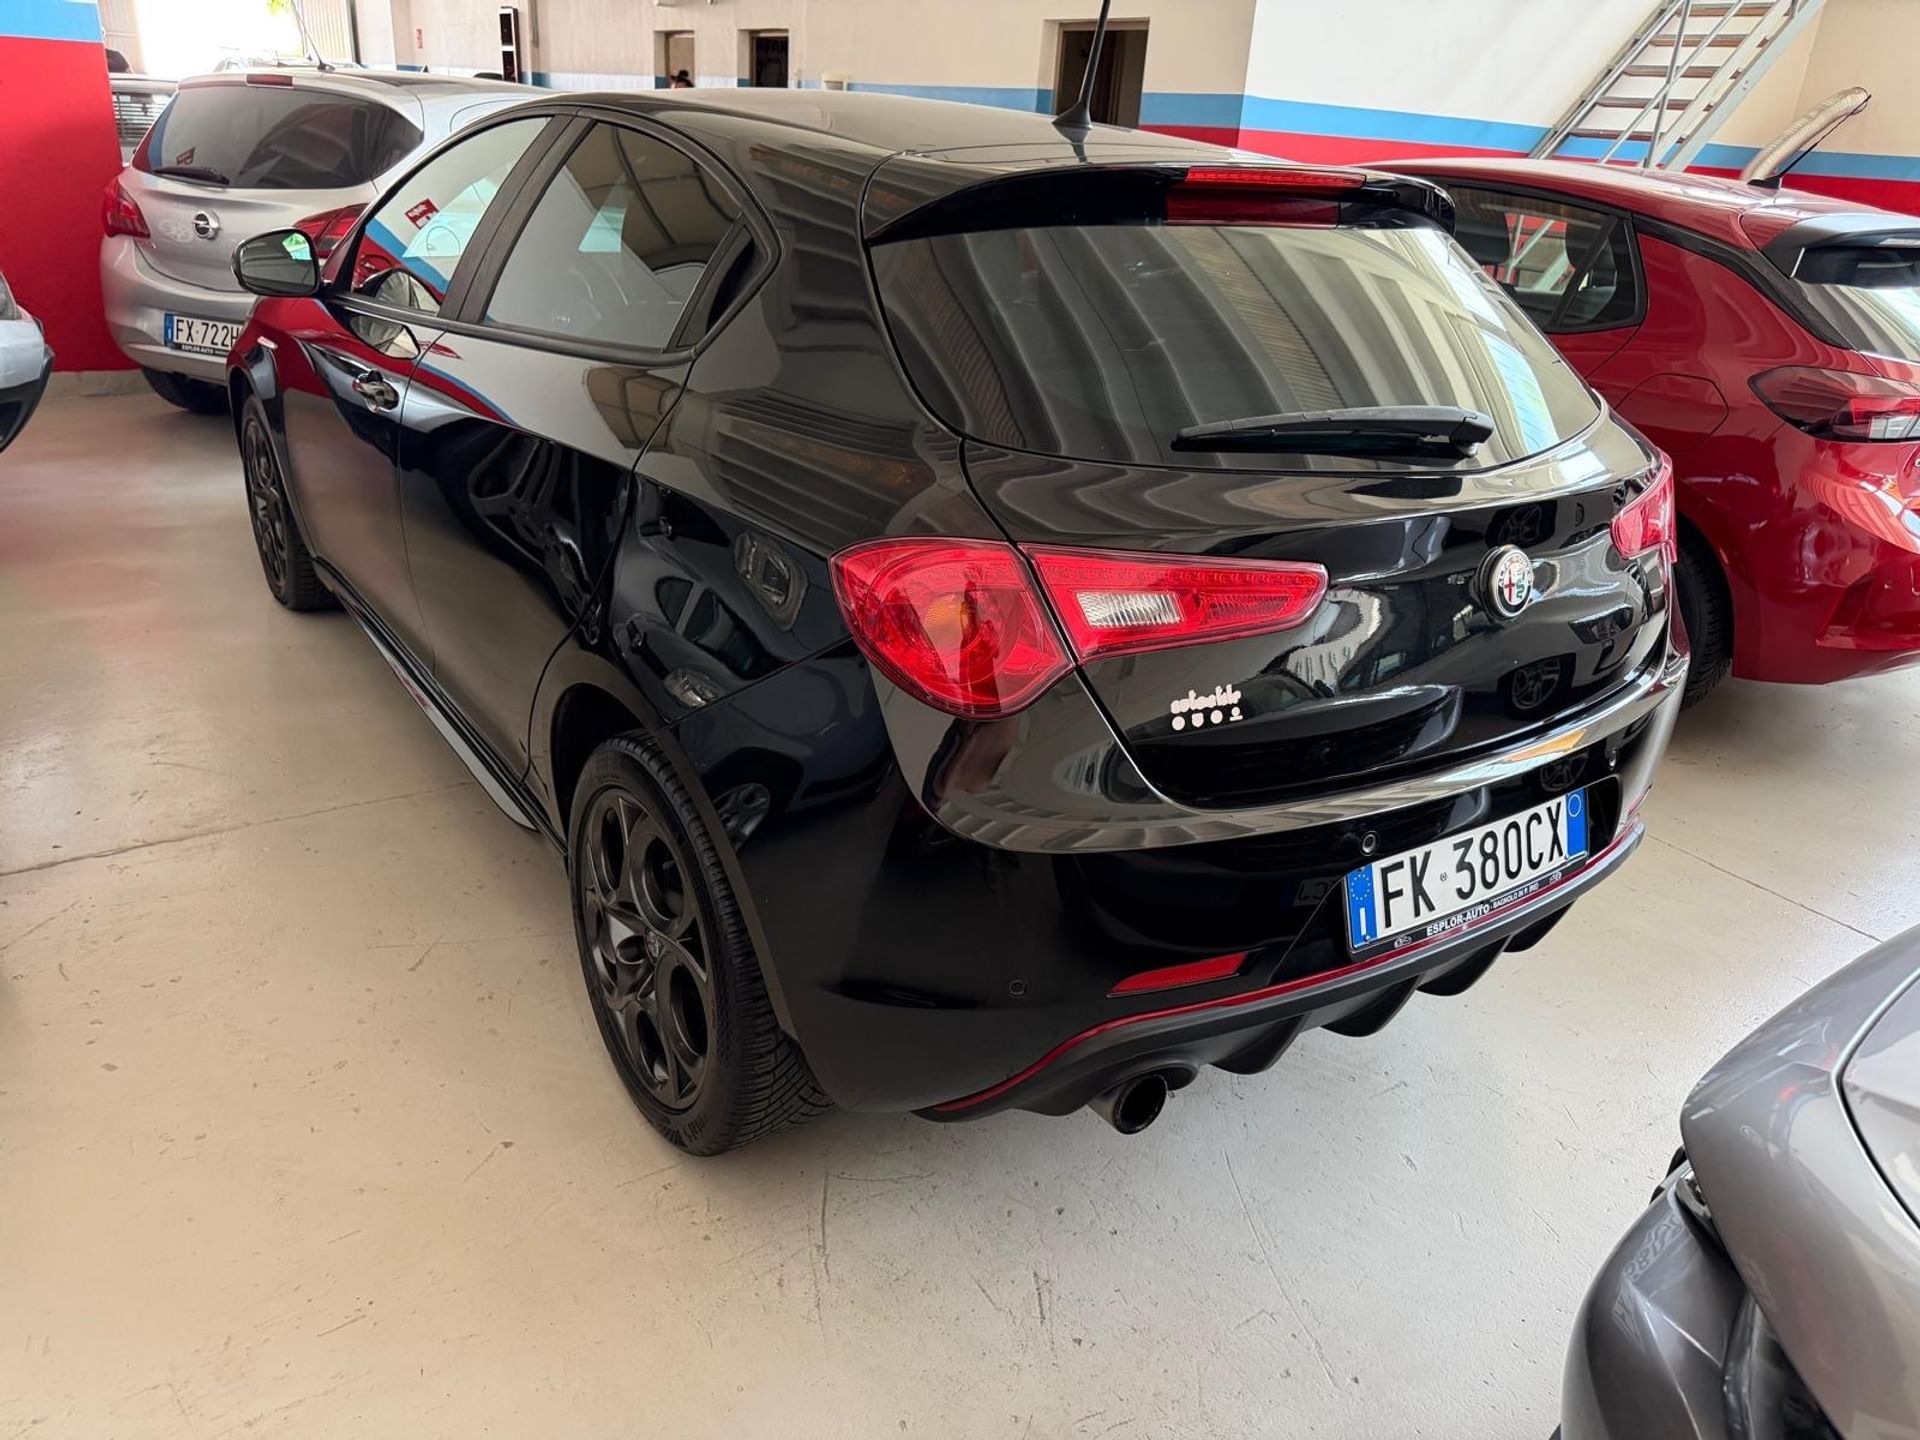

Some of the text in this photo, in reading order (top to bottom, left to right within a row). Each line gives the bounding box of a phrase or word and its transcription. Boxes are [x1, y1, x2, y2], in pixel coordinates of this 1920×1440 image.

[176, 319, 194, 343] FX
[1380, 850, 1436, 929] FK
[1452, 802, 1564, 900] 380CX
[1426, 903, 1491, 936] ESPLOR-AUTO
